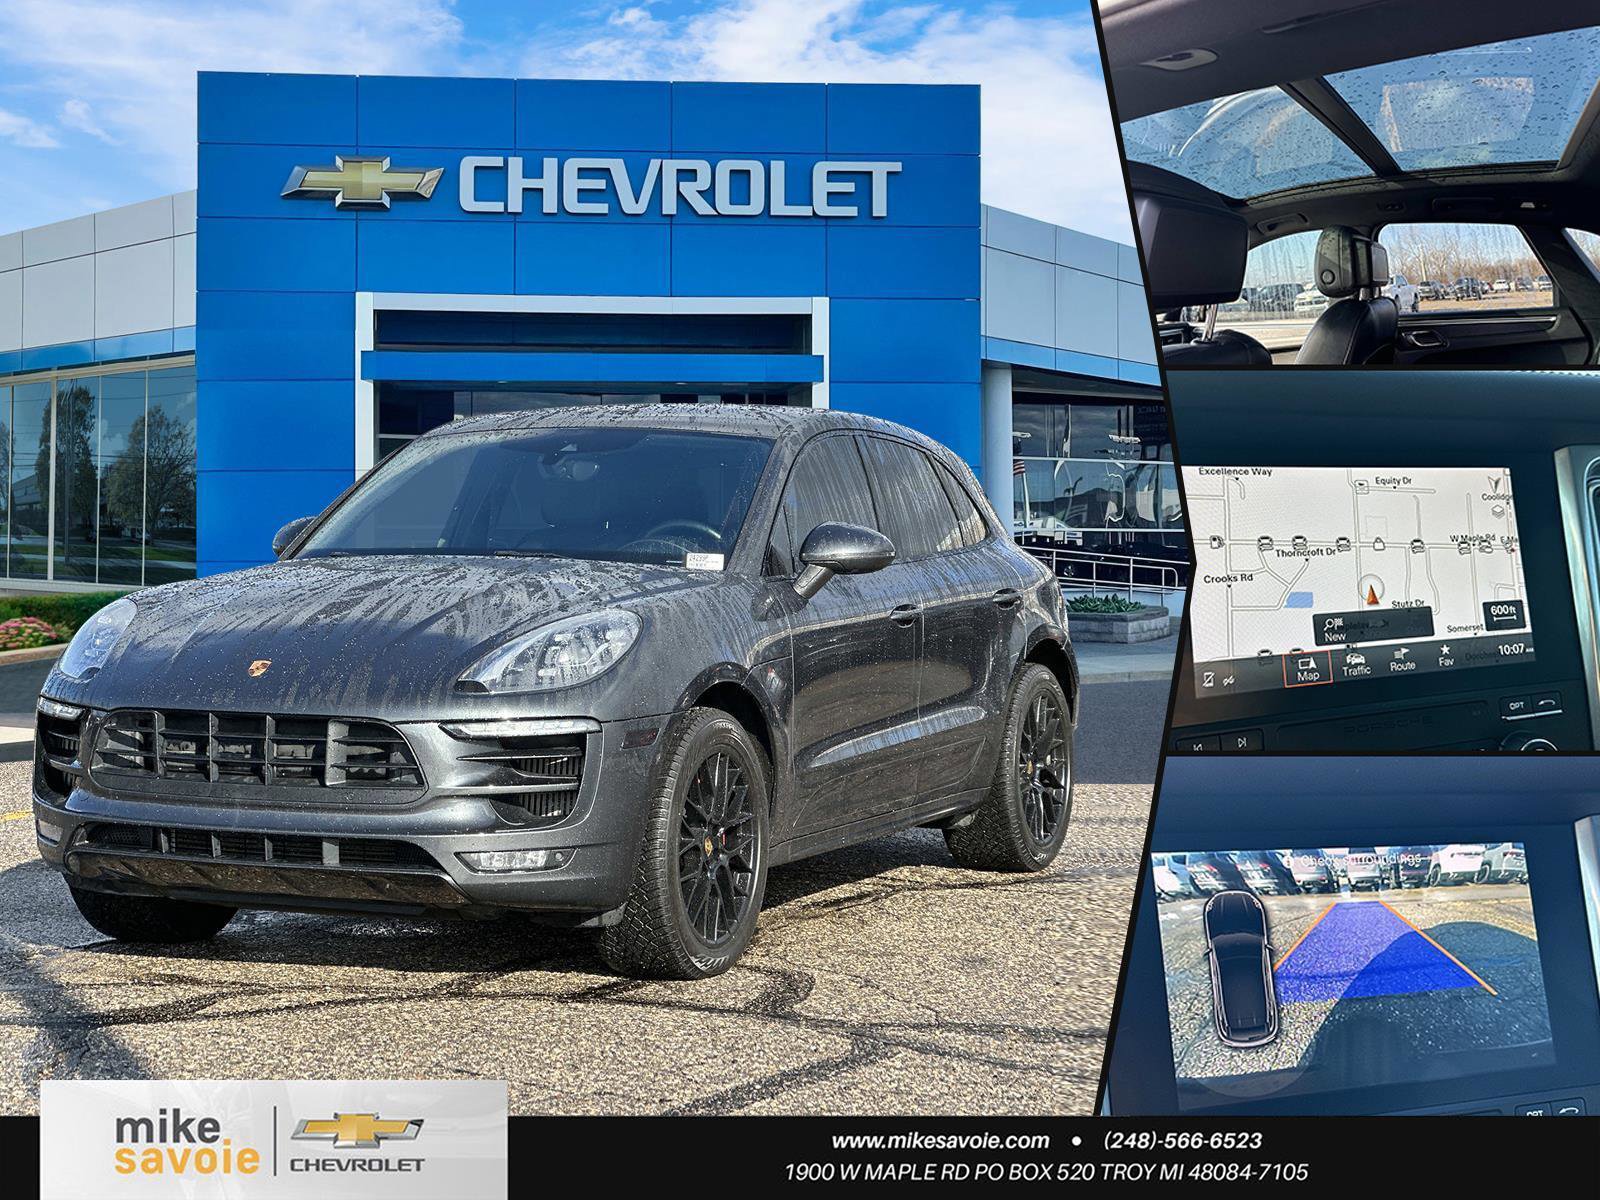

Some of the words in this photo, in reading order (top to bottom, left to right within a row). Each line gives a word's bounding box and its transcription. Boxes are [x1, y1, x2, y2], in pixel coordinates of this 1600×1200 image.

[459, 155, 903, 218] CHEVROLET
[1198, 467, 1250, 476] Excellence
[1252, 467, 1273, 477] Way
[1375, 476, 1401, 486] Equity
[1402, 476, 1412, 485] Dr
[1450, 534, 1459, 542] W
[1460, 534, 1484, 543] Maple
[1485, 533, 1496, 541] Rd
[1276, 549, 1325, 558] Thorncroft
[1325, 549, 1336, 557] Dr
[1203, 574, 1238, 584] Crooks
[1240, 573, 1254, 582] Rd
[1391, 600, 1413, 608] Stutz
[1414, 599, 1425, 607] Dr
[1446, 624, 1485, 634] Somerset
[1324, 632, 1346, 643] New
[1498, 643, 1524, 655] 10:07
[1390, 660, 1416, 673] Route
[1438, 656, 1454, 668] Fav
[1342, 664, 1372, 677] Traffic
[1297, 671, 1320, 682] Map
[1508, 701, 1525, 711] OPT
[1300, 854, 1340, 867] Check
